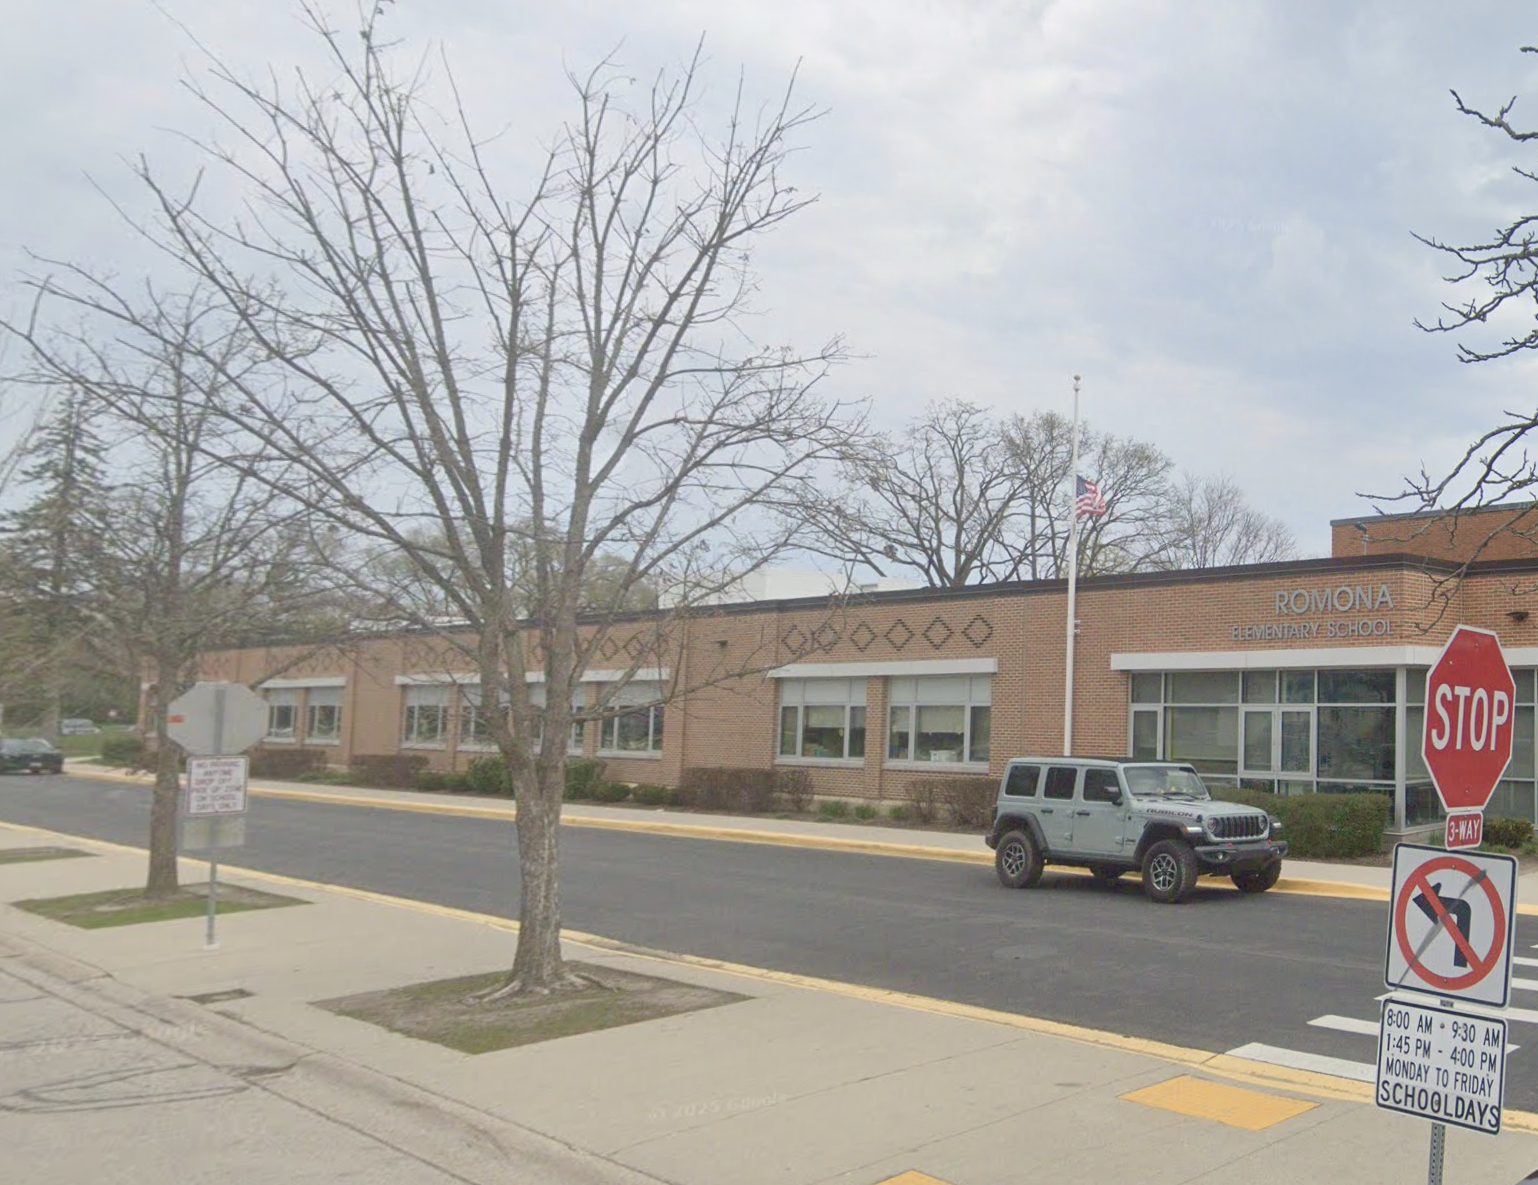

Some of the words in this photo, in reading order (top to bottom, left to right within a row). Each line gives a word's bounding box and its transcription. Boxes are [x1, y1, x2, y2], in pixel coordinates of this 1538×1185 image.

[1275, 584, 1394, 616] ROMONA
[1232, 622, 1320, 641] ELEMENTARY
[1328, 618, 1394, 638] SCHOOL
[1431, 683, 1509, 752] STOP
[1448, 818, 1480, 842] 3-WAY
[1386, 1008, 1410, 1030] 8:00
[1416, 1014, 1433, 1035] AM
[1452, 1021, 1476, 1043] 9:30
[1483, 1027, 1500, 1048] AM
[1387, 1033, 1411, 1054] 1:45
[1415, 1038, 1431, 1059] PM
[1450, 1046, 1475, 1068] 4:00
[1480, 1051, 1497, 1073] PM
[1385, 1057, 1430, 1083] MONDAY
[1436, 1067, 1449, 1088] TO
[1454, 1071, 1494, 1098] FRIDAY
[1380, 1080, 1500, 1128] SCHOOLDAYS
